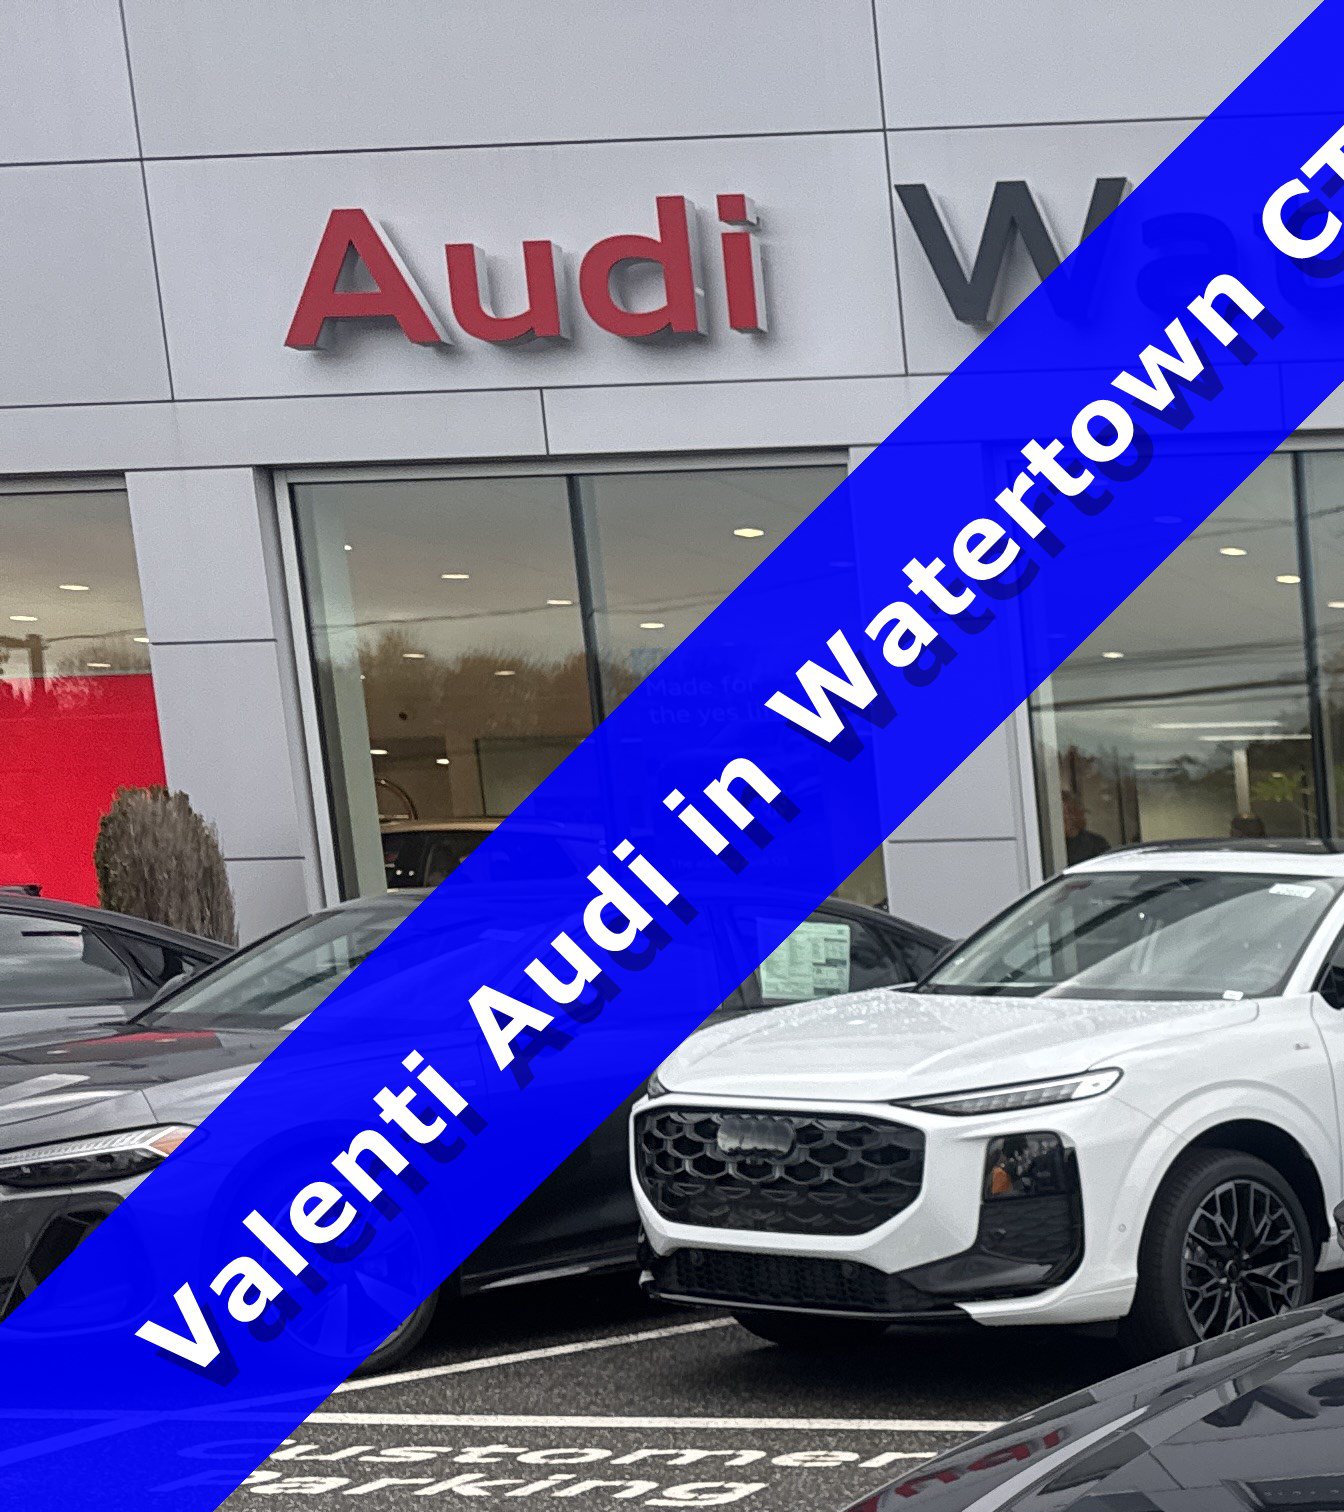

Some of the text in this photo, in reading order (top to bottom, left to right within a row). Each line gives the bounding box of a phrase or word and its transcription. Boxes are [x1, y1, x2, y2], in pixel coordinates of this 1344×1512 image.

[284, 194, 768, 350] Audi
[176, 1438, 938, 1468] Customer
[146, 1469, 768, 1507] Parking
